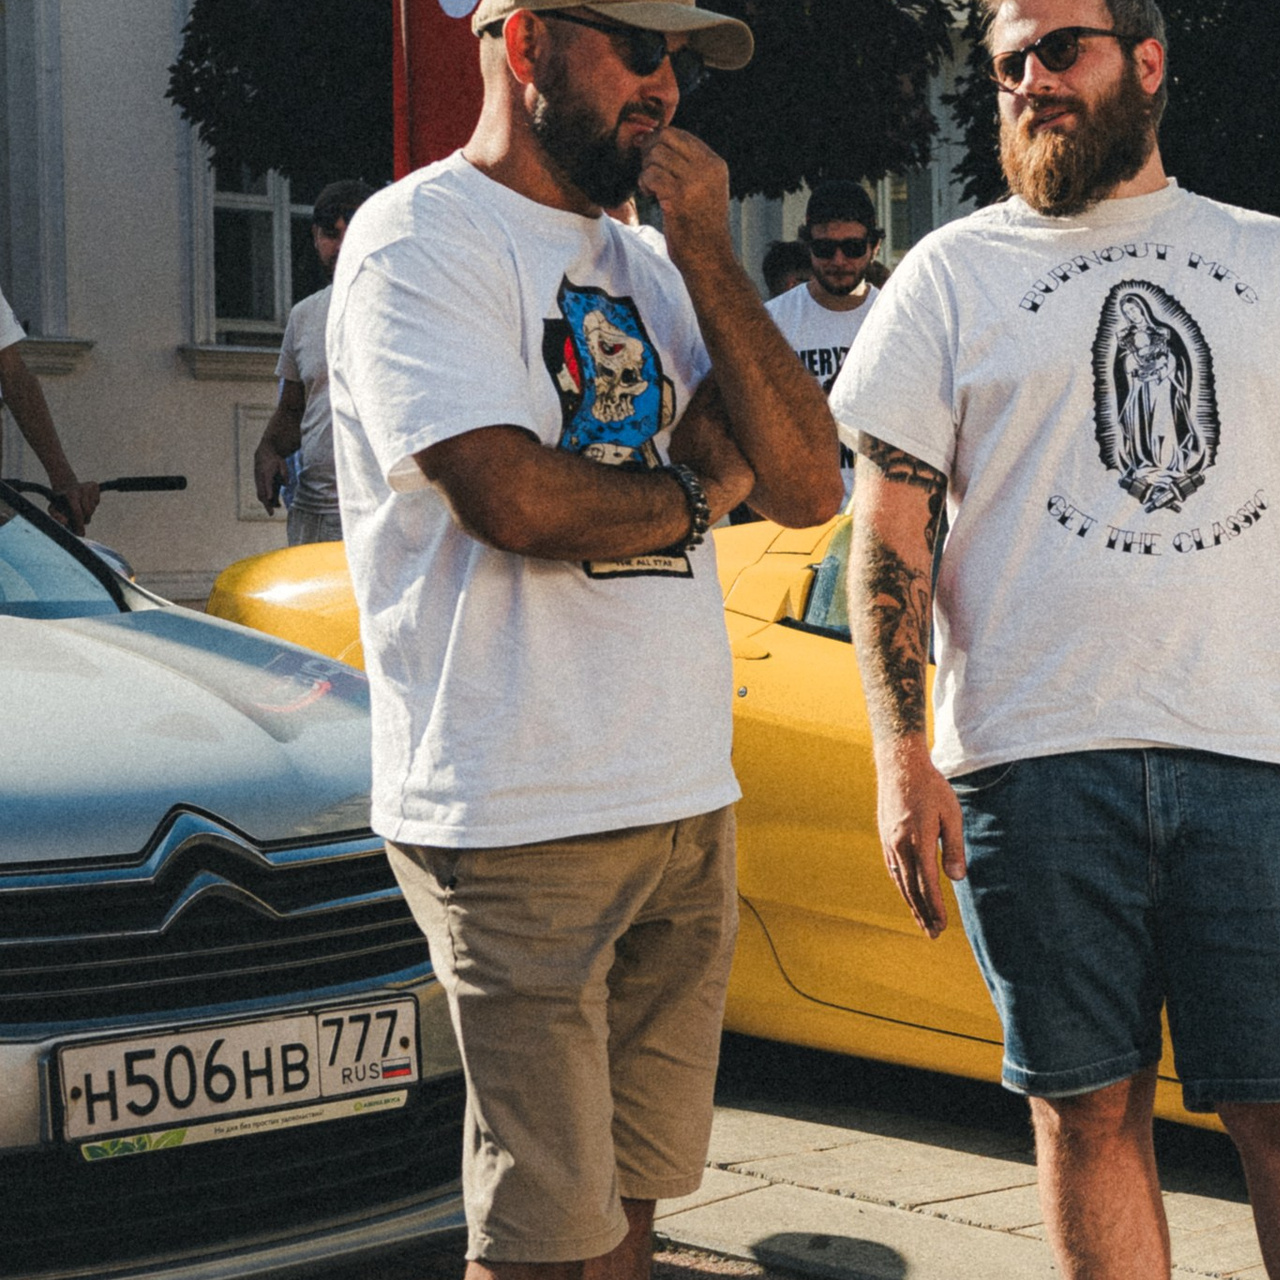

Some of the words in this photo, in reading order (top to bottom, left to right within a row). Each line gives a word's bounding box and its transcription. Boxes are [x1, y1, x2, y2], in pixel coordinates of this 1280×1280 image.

[1019, 242, 1174, 313] BURNOUT
[1188, 251, 1259, 305] MFG
[1047, 494, 1098, 538] GET
[1105, 524, 1162, 556] THE
[1172, 488, 1269, 554] CLASSIC
[321, 1009, 399, 1067] 777
[342, 1062, 380, 1085] RUS
